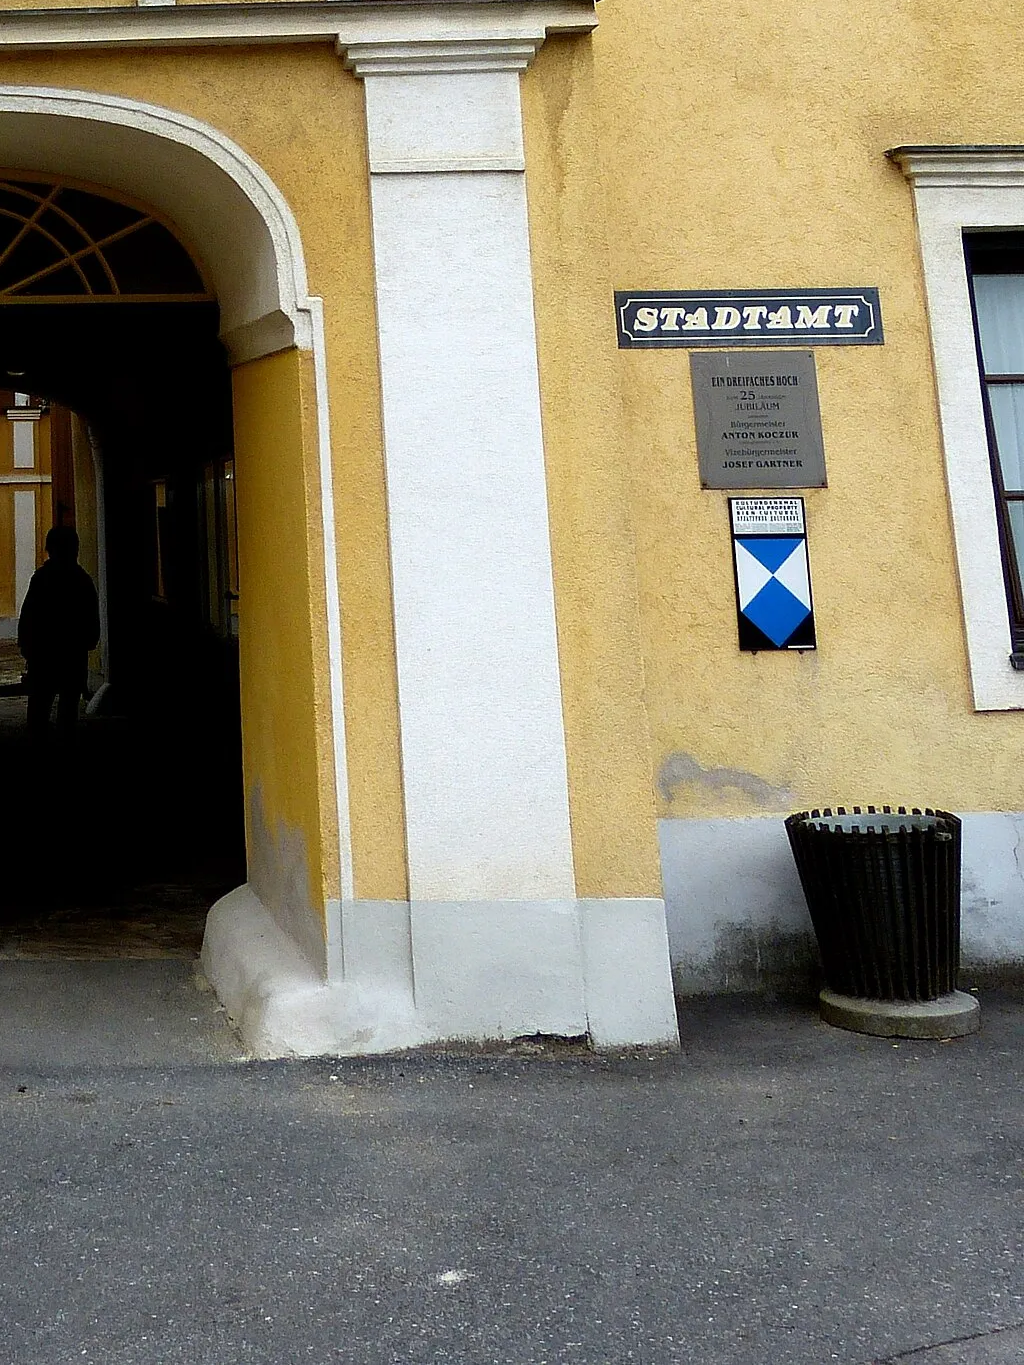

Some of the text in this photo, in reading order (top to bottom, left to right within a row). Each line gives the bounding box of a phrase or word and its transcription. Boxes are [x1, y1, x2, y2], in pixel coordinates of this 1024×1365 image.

[634, 304, 859, 331] STADTAMT
[711, 376, 799, 387] EIN DREIFACHES HOCH
[739, 391, 756, 400] 25
[735, 401, 780, 411] JUBILÄUM
[730, 420, 786, 429] Bürgermeister
[721, 431, 756, 440] ANTON
[725, 448, 797, 457] Vizebürgermeister
[722, 460, 754, 468] JOSEF
